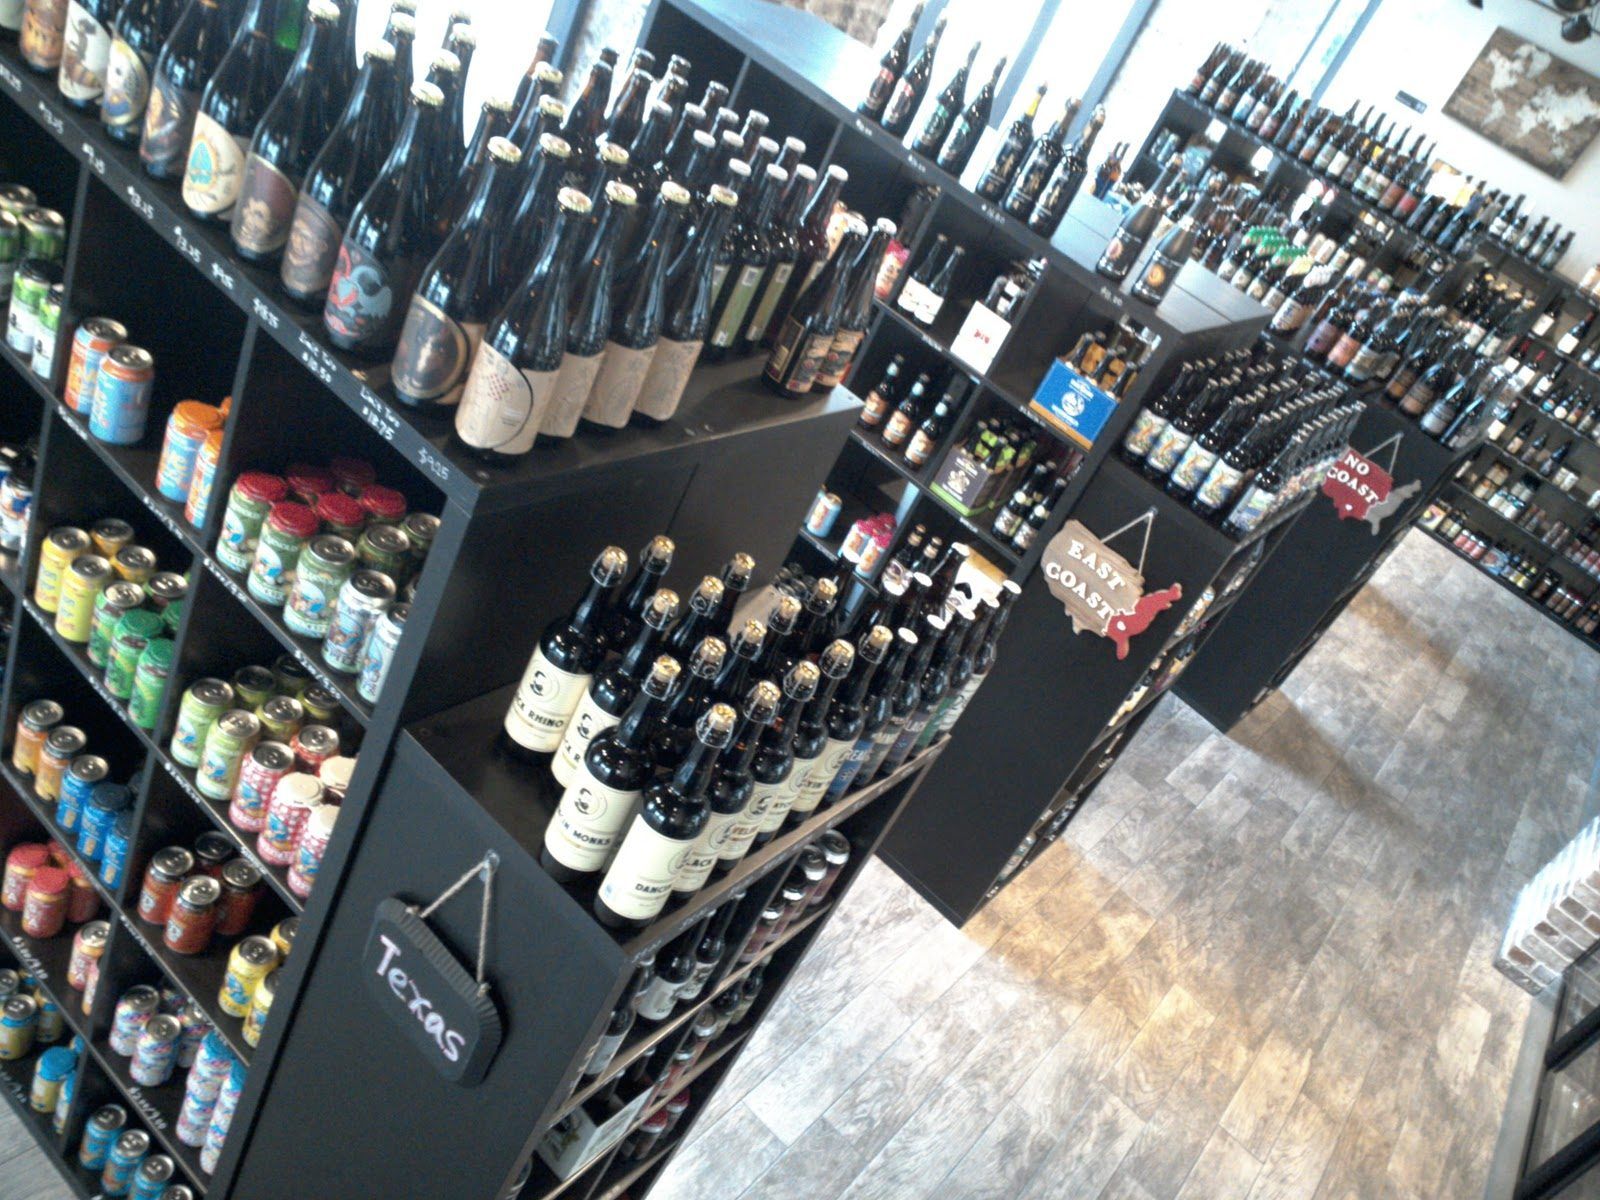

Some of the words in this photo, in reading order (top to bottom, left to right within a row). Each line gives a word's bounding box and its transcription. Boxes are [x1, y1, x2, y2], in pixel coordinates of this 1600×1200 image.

[1342, 452, 1370, 477] NO
[1326, 466, 1379, 504] COAST
[1067, 538, 1126, 592] EAST
[1045, 561, 1117, 620] COAST
[527, 710, 565, 729] RHINO
[572, 829, 612, 846] MONKS
[376, 934, 467, 1062] Texas
